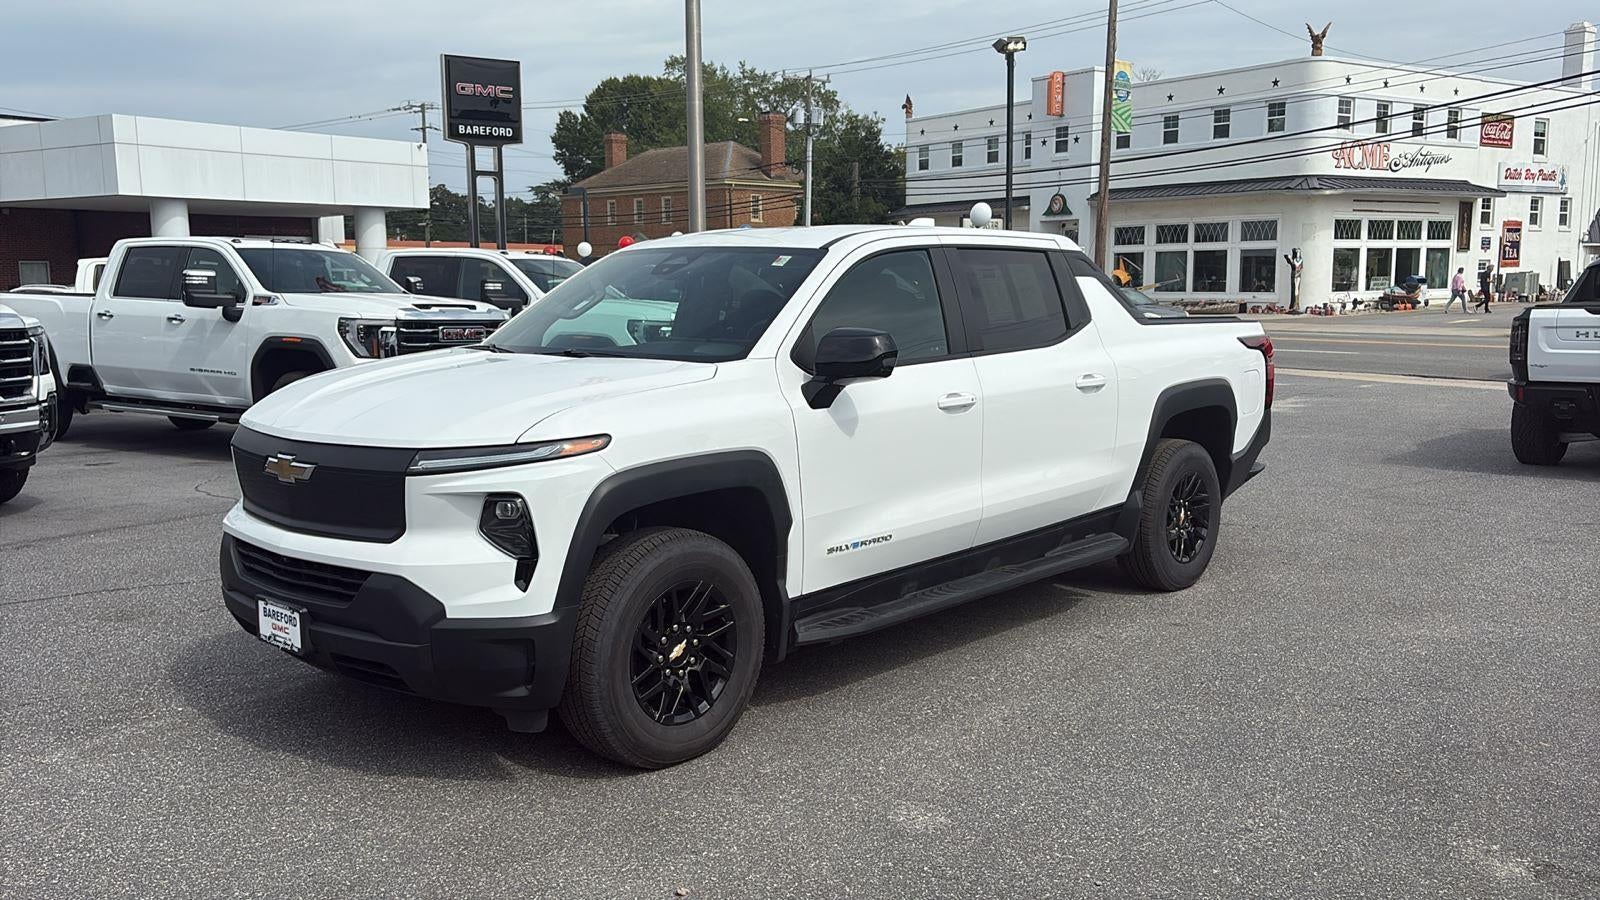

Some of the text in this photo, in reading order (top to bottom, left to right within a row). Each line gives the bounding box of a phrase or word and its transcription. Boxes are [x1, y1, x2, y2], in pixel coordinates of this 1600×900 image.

[456, 82, 513, 98] GMC
[458, 124, 513, 137] BAREFORD
[1332, 140, 1453, 172] ACME Antiques
[1504, 167, 1557, 183] Dutch Boy Paints
[1504, 246, 1517, 258] TEA
[443, 328, 485, 340] GMC
[826, 534, 893, 555] SILVERADO
[263, 607, 297, 627] BAREFORD
[272, 623, 289, 635] GMC
